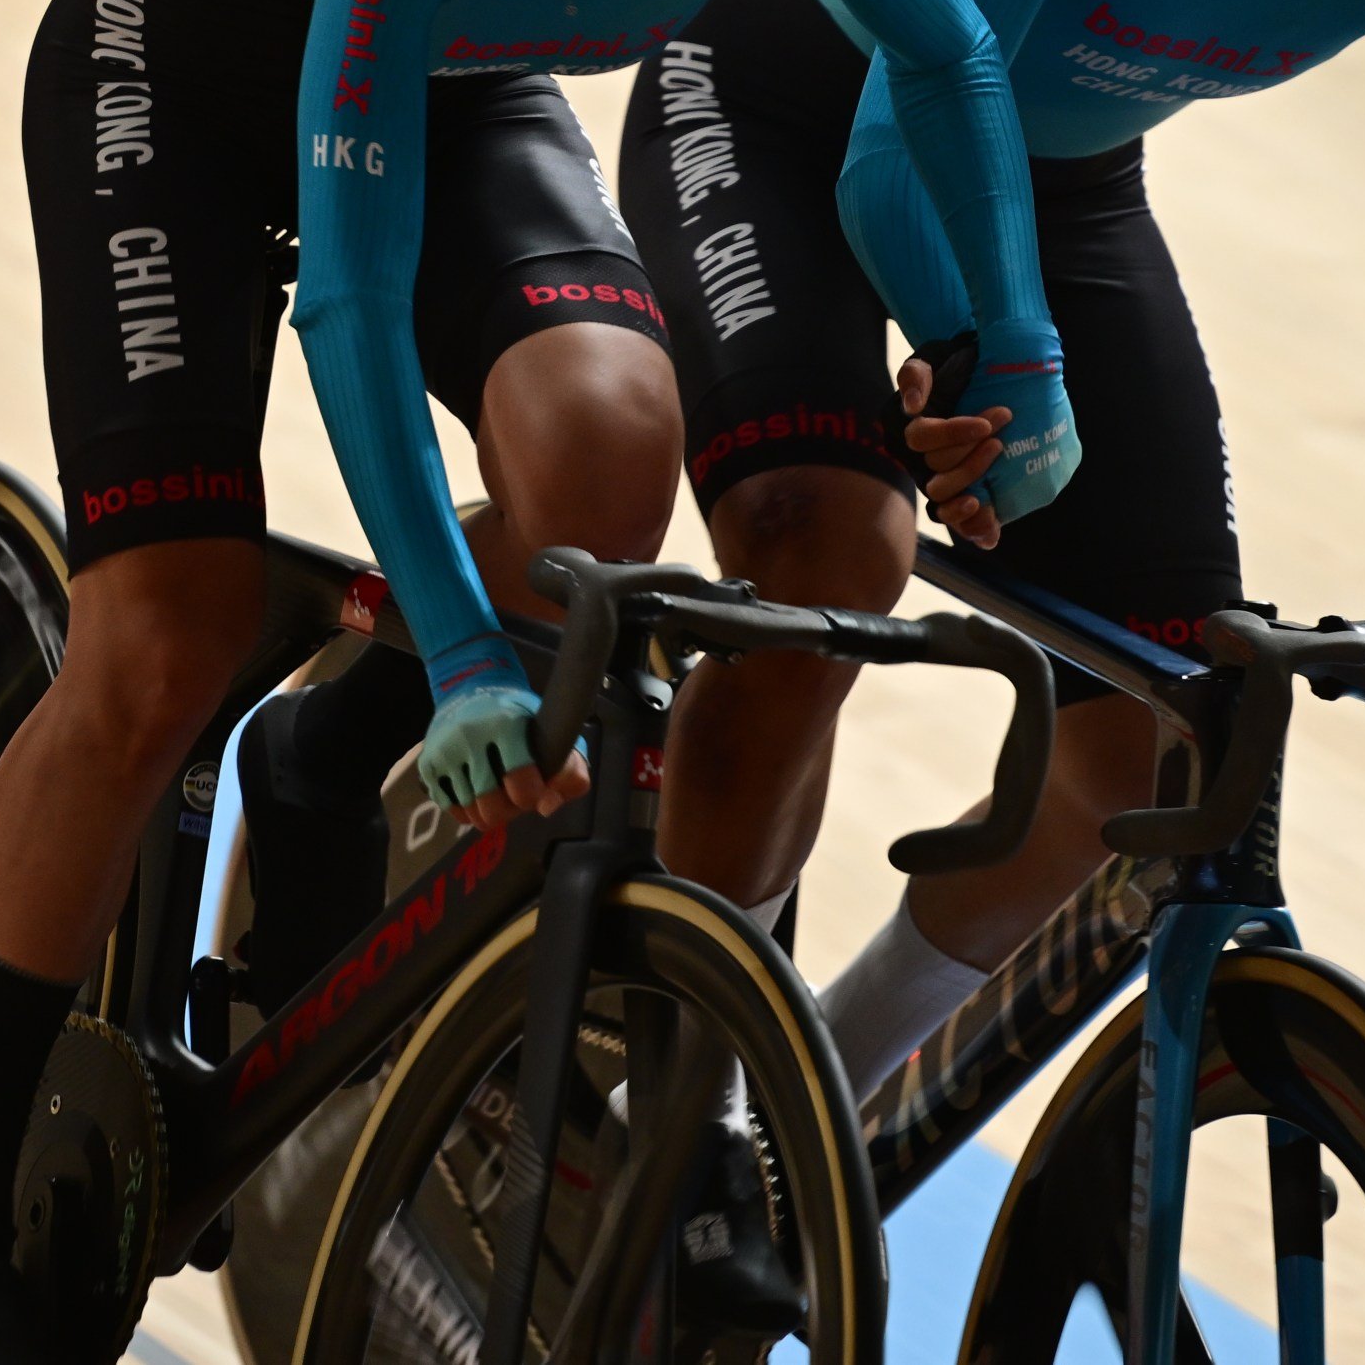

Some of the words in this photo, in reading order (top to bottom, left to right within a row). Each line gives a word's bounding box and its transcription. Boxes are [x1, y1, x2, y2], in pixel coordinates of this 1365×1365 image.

[1062, 43, 1158, 81] HONG
[1085, 3, 1315, 76] bossini.X
[1071, 75, 1180, 103] CHINA
[313, 133, 385, 177] HKG
[108, 222, 185, 383] CHINA
[694, 222, 778, 341] CHINA
[231, 873, 447, 1105] ARGON
[861, 856, 1143, 1173] ACTOR
